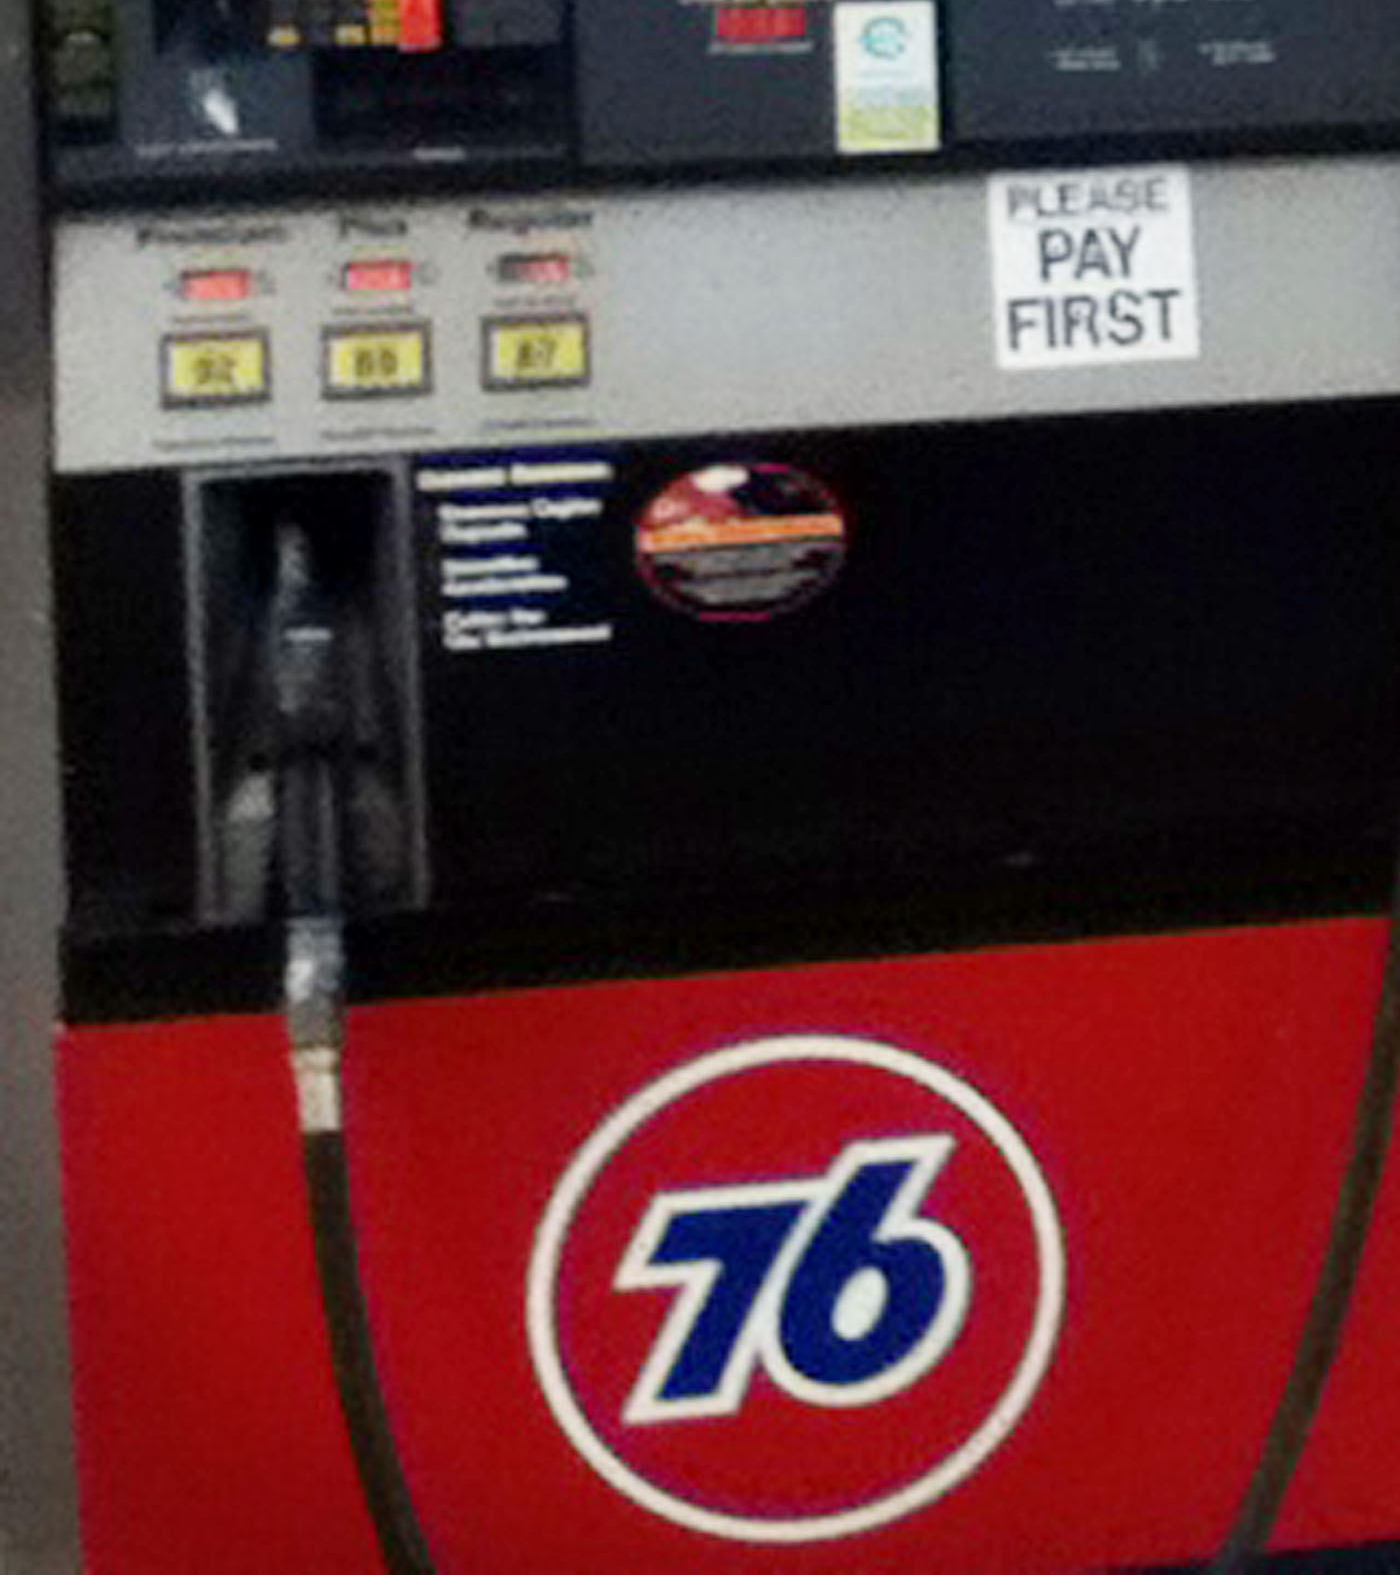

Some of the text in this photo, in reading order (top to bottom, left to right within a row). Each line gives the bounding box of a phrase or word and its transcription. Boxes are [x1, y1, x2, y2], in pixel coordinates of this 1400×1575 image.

[1006, 177, 1171, 218] PLEASE
[1037, 226, 1142, 282] PAY
[1006, 290, 1182, 351] FIRST
[614, 1135, 973, 1425] 76
